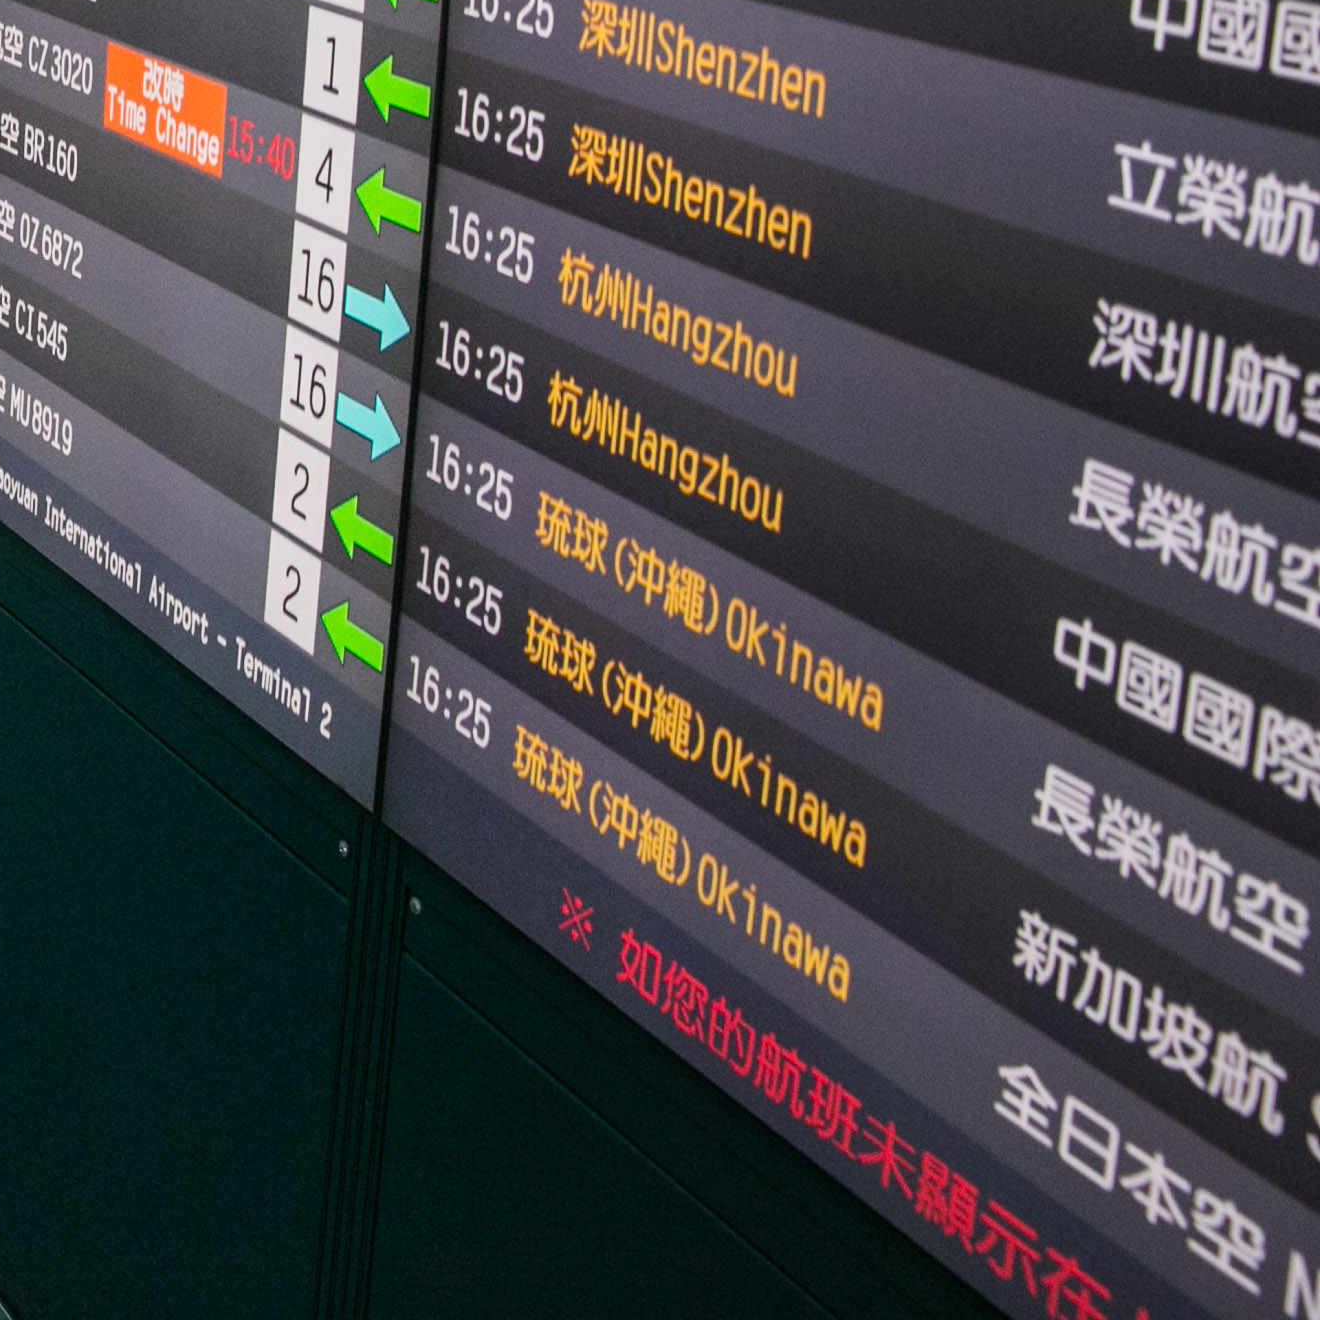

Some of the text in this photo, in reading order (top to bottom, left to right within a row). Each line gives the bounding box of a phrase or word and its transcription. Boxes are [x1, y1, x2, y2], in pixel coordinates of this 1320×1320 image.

[107, 84, 220, 167] Time Change
[322, 36, 340, 96] 1
[226, 115, 295, 180] 15:40
[314, 148, 334, 203] 4
[454, 87, 812, 259] 16:25 深圳Shenzhen
[297, 248, 335, 314] 16
[445, 205, 798, 397] 16:25 杭州Hangzhou
[289, 353, 327, 420] 16
[435, 320, 784, 533] 16:25 杭州Hangzhou
[290, 462, 310, 521] 2
[44, 495, 142, 594] International
[148, 575, 209, 645] Airport
[235, 636, 311, 723] Terminal
[319, 701, 333, 739] 2
[282, 564, 302, 623] 2
[426, 434, 514, 521] 16:25
[1031, 764, 1310, 974] 長榮航空
[416, 546, 503, 636] 16:25
[1012, 909, 1288, 1136] 新加坡航
[406, 655, 492, 749] 16:25
[994, 1064, 1266, 1295] 全日本空
